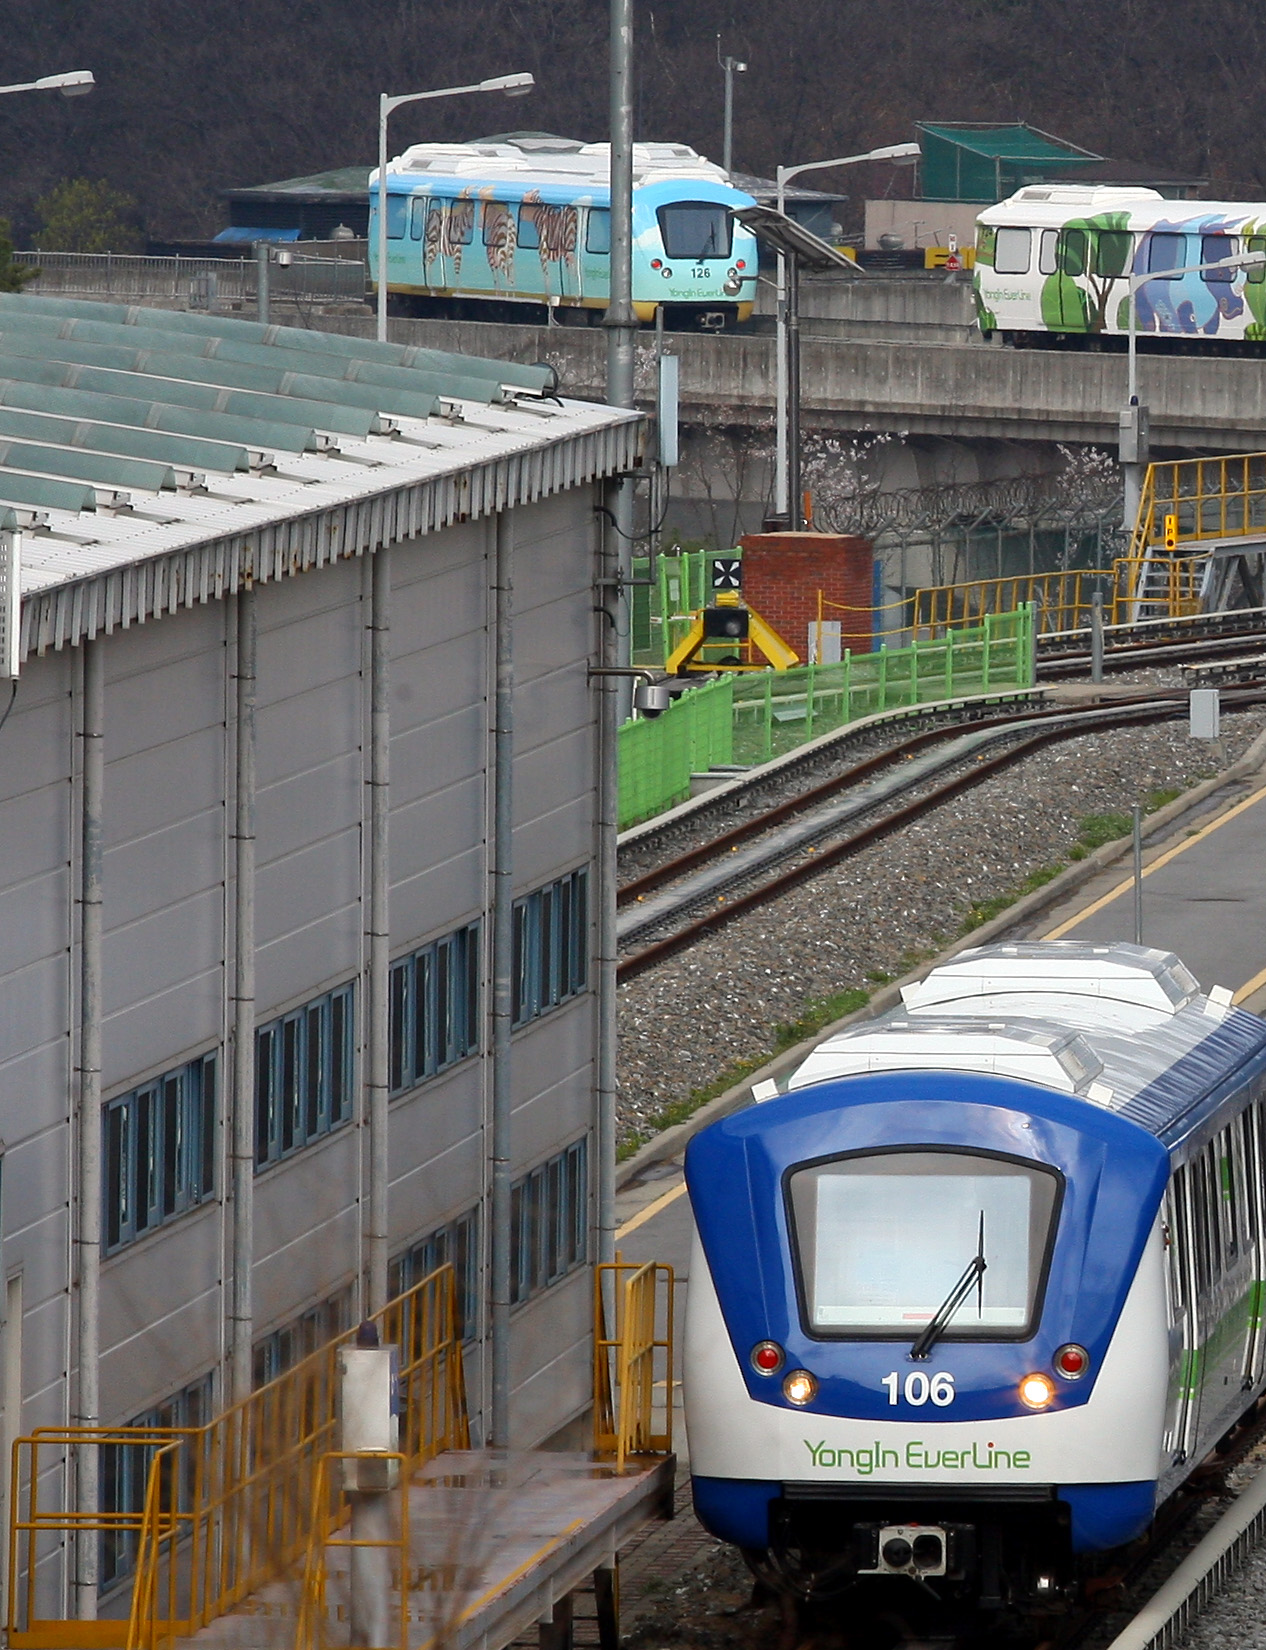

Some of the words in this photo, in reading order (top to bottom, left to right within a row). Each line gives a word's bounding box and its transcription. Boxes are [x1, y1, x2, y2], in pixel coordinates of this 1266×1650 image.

[690, 267, 711, 279] 126
[881, 1370, 956, 1407] 106
[803, 1438, 899, 1475] YongIn
[905, 1441, 1031, 1470] EverLine
